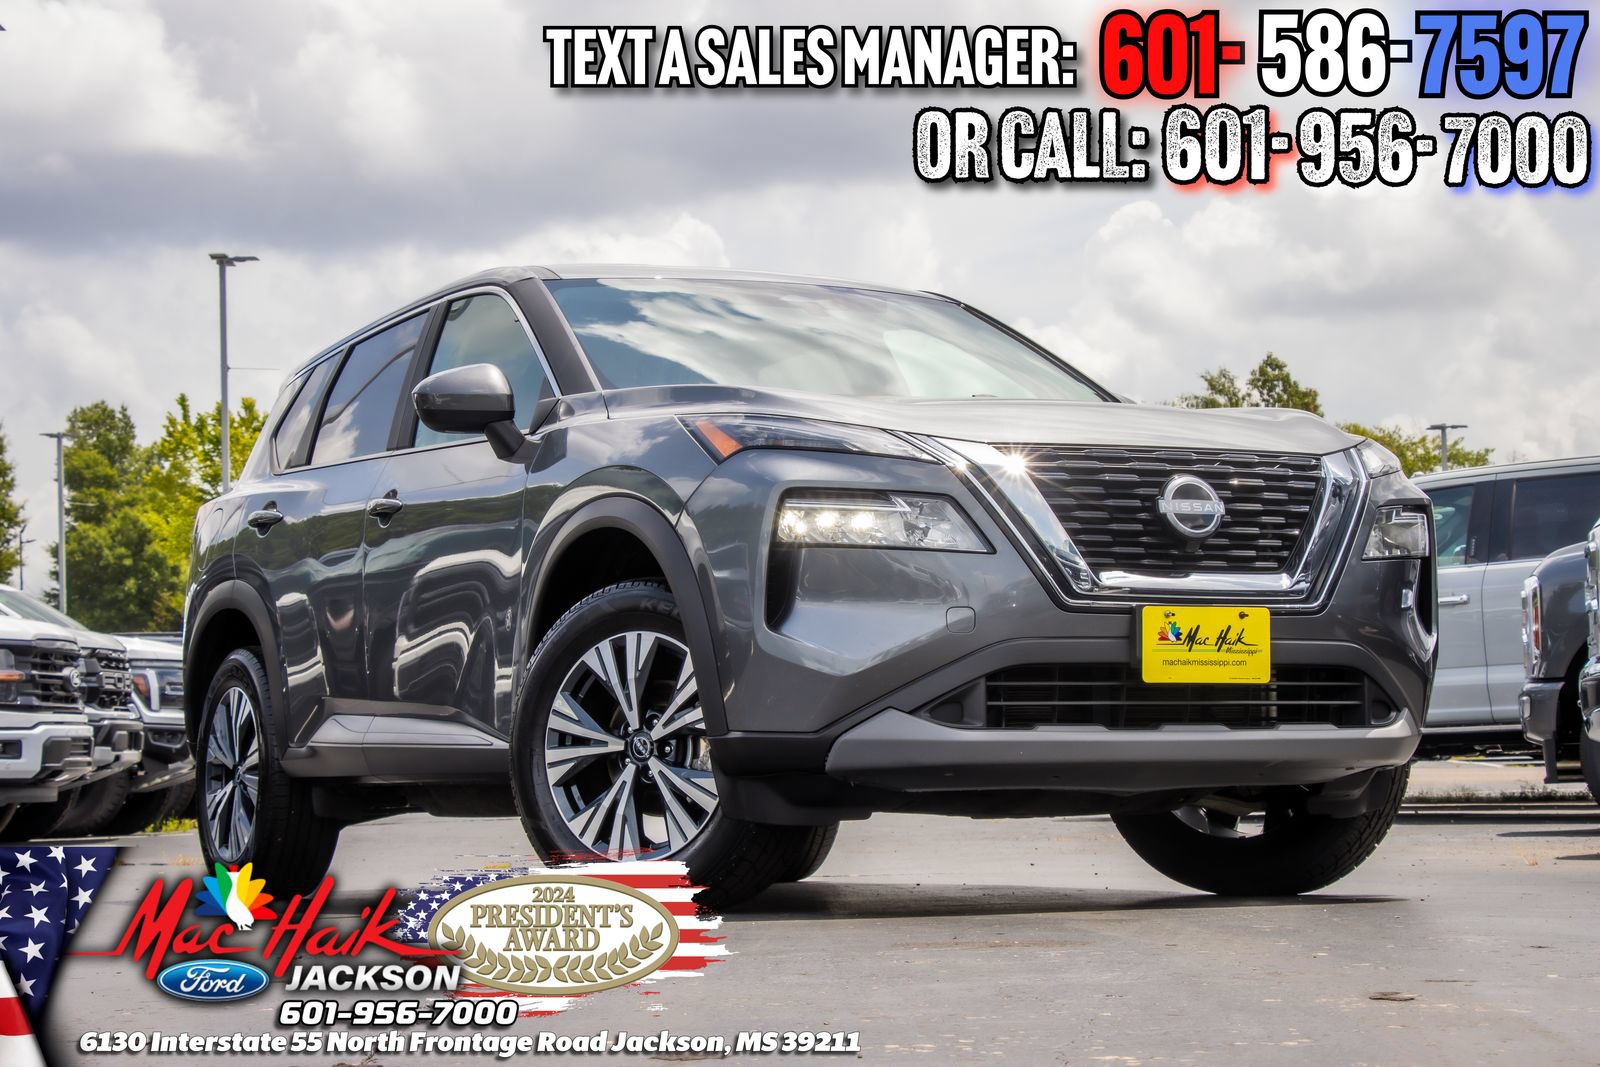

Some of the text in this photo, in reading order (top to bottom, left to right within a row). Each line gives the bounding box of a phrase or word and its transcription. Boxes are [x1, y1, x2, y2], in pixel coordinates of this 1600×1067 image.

[1160, 501, 1225, 514] NISSAN
[1182, 624, 1246, 652] Mac Haik
[1162, 658, 1247, 667] machaikmississippi.com
